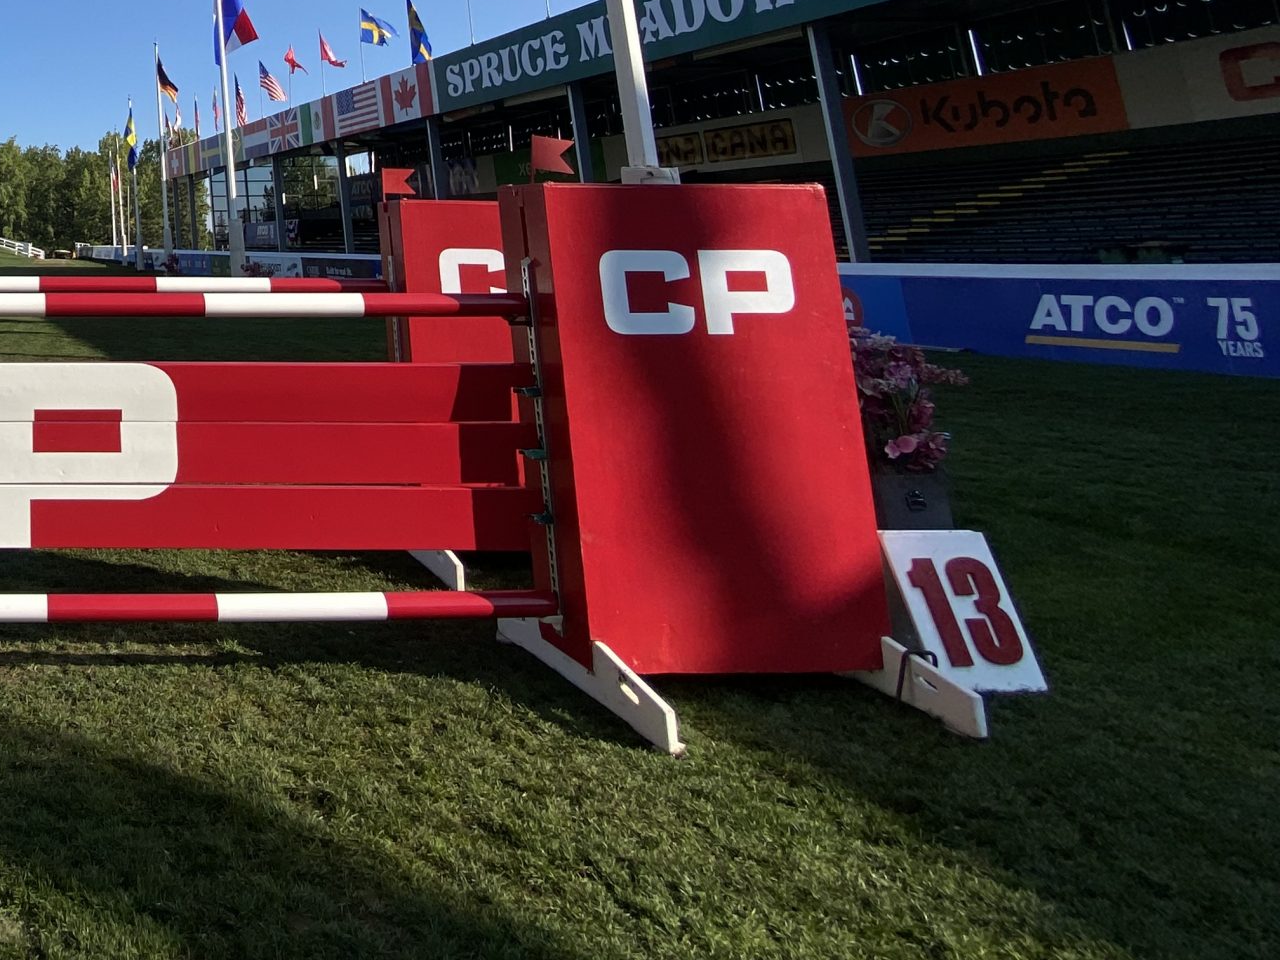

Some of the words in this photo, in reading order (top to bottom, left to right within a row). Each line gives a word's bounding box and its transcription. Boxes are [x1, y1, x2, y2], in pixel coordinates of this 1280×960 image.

[445, 29, 570, 98] SPRUCE
[919, 80, 1098, 133] Kubota
[598, 249, 796, 335] CP
[1206, 297, 1259, 341] 75
[1217, 340, 1264, 358] YEARS
[906, 556, 1024, 667] 13
